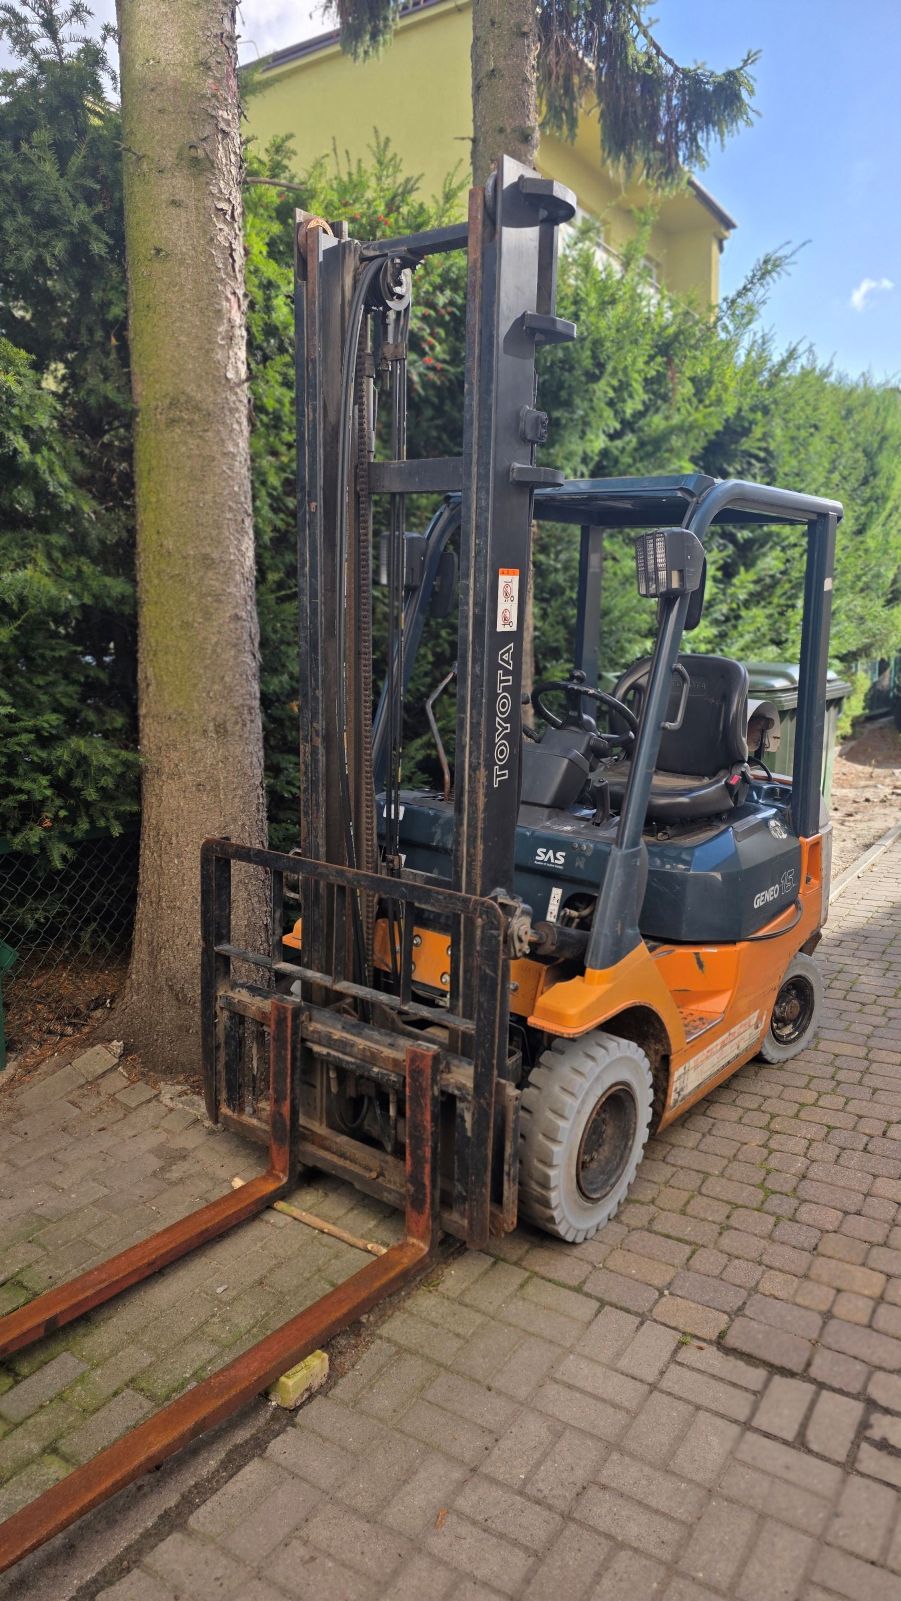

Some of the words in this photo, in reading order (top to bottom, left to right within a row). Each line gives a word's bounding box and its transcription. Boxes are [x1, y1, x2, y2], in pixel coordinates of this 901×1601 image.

[493, 642, 514, 788] TOYOTA
[535, 847, 566, 865] SAS
[753, 884, 780, 909] GENEO
[780, 868, 796, 895] 15
